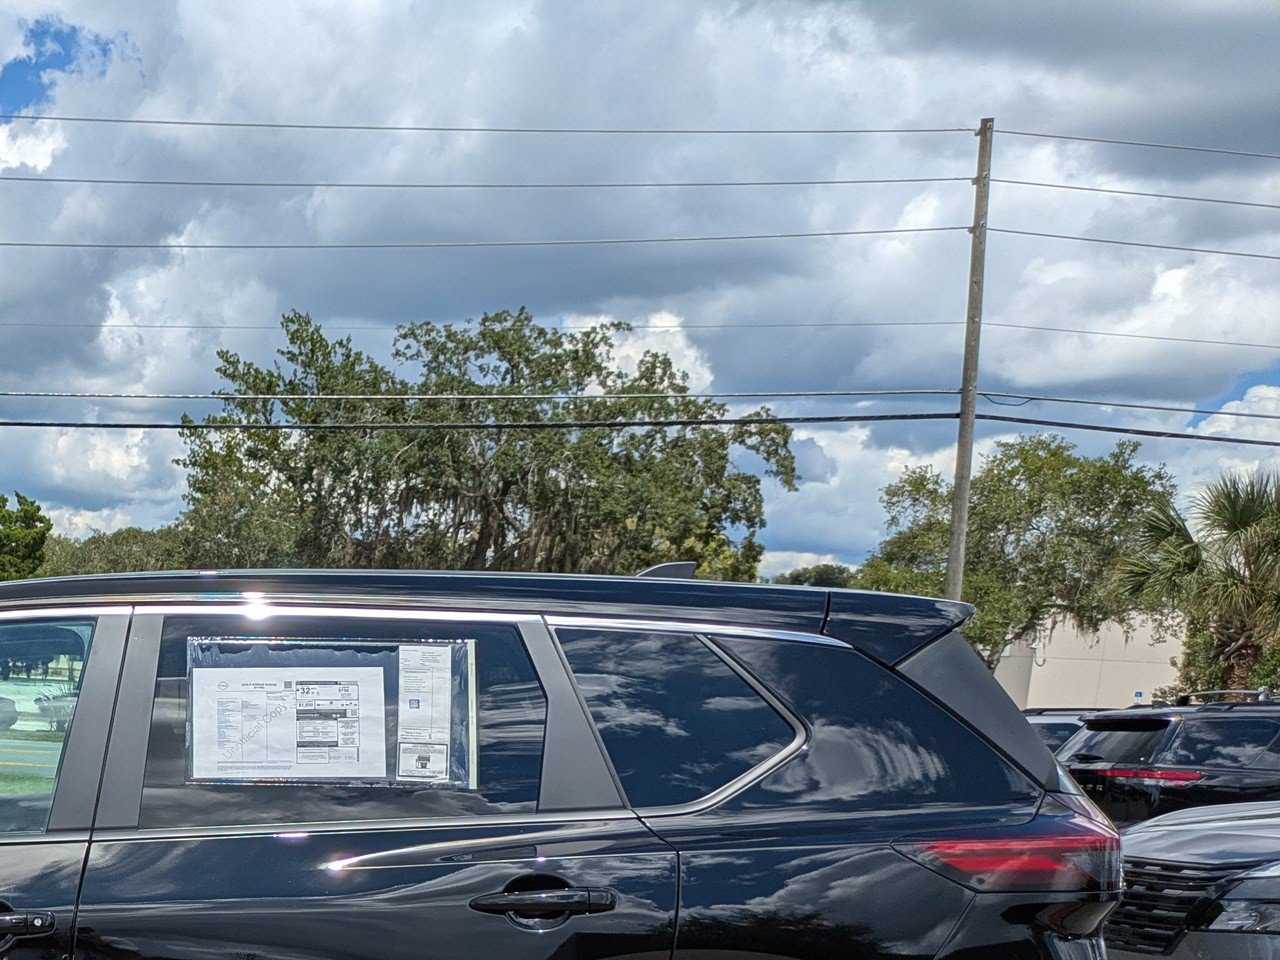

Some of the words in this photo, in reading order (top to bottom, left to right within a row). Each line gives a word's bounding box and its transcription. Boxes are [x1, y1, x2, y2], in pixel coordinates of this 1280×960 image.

[300, 687, 311, 695] 32
[223, 721, 265, 759] Unofficial
[262, 702, 288, 724] Copy
